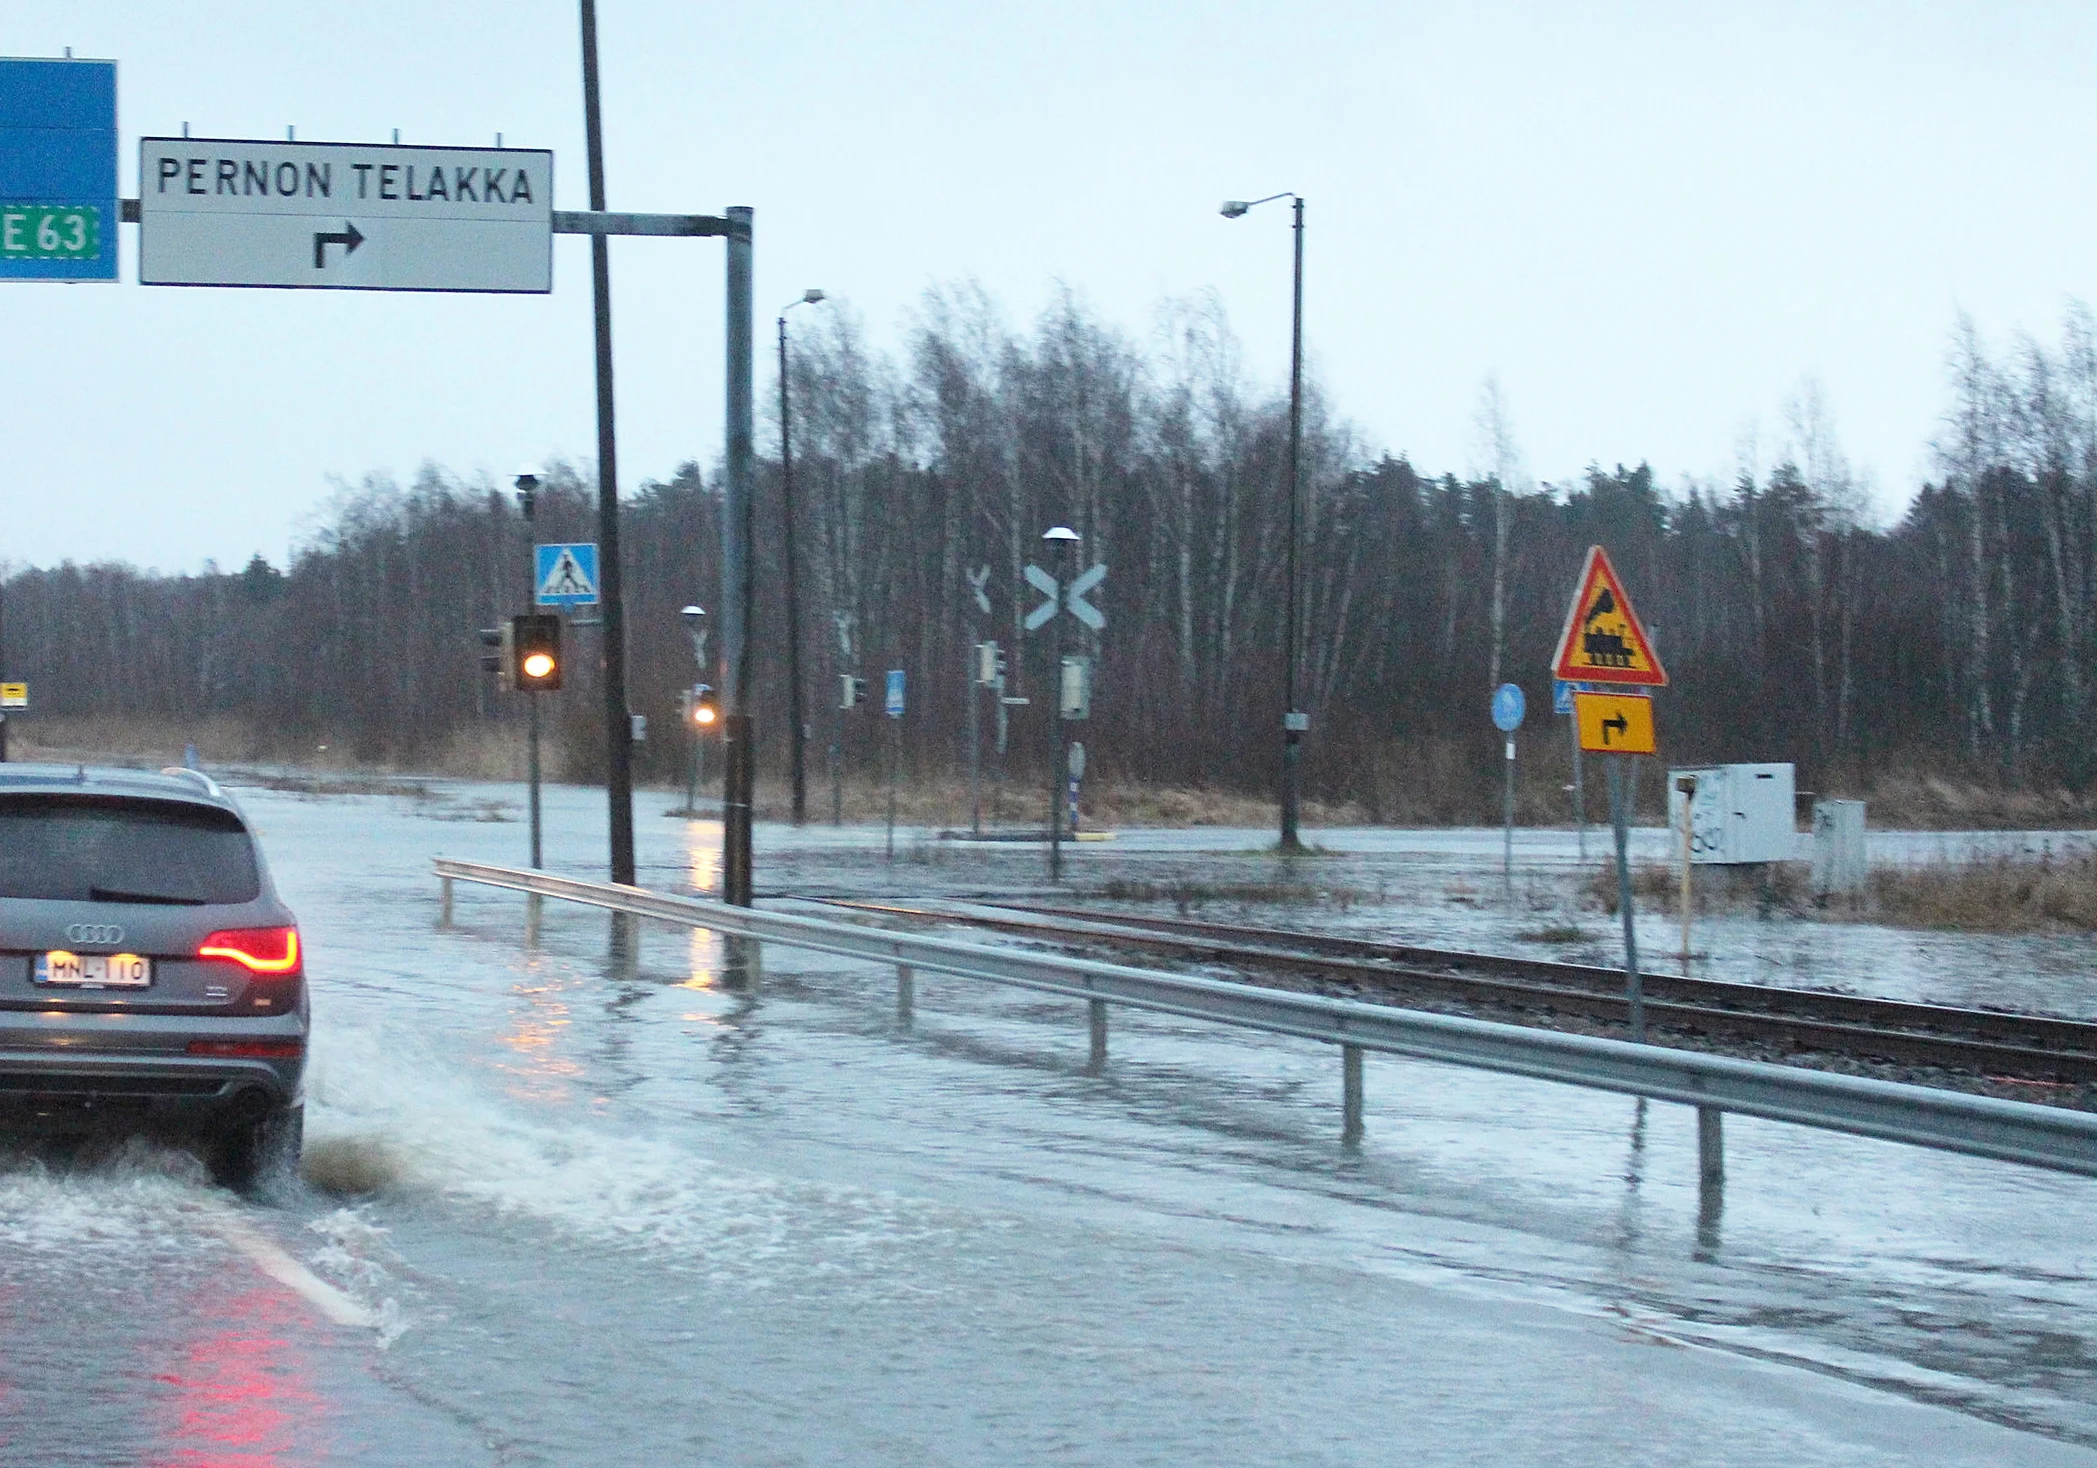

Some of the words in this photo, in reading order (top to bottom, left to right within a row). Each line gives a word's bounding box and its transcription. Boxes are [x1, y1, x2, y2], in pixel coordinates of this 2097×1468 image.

[158, 157, 332, 198] PERNON
[351, 164, 533, 204] TELAKKA
[3, 213, 26, 250] E
[37, 214, 86, 251] 63
